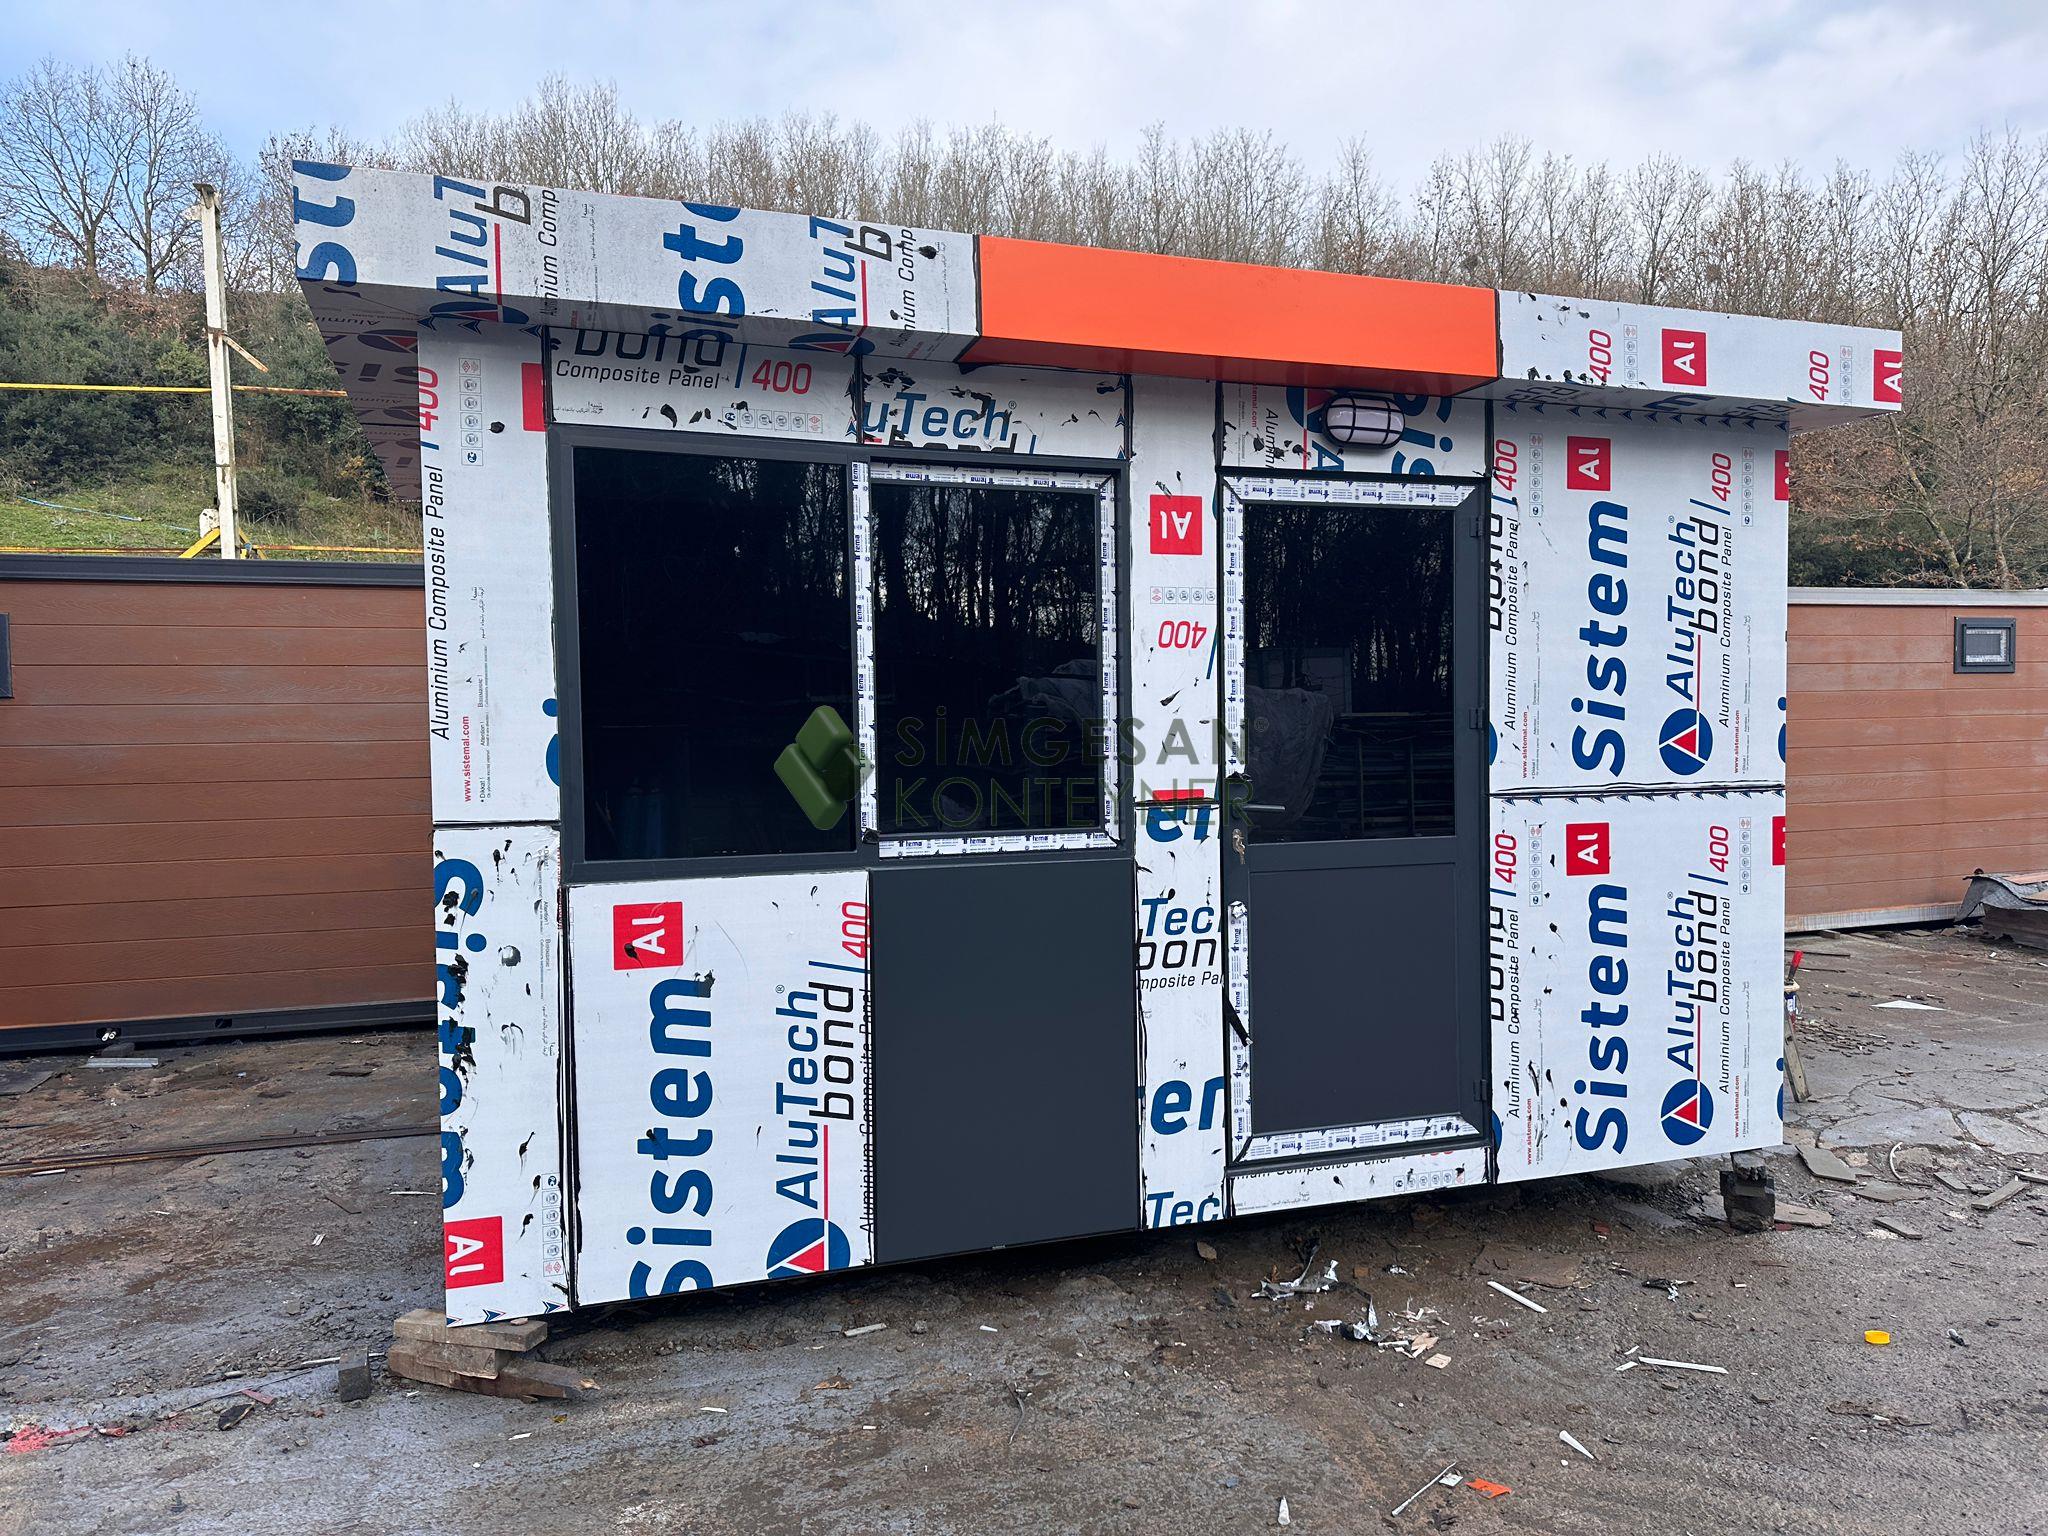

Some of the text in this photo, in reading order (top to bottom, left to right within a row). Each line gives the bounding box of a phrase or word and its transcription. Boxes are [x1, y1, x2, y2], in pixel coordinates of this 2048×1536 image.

[556, 359, 720, 390] Composite Panel
[752, 359, 812, 395] 400
[1589, 329, 1612, 386] 400
[1809, 350, 1830, 401] 400
[1495, 439, 1518, 491] 400
[1578, 447, 1600, 481] Al
[1688, 452, 1732, 634] bond 400
[424, 464, 450, 741] Aluminium Composite Panel
[1504, 518, 1519, 731] Aluminium Composite Panel
[1718, 527, 1732, 728] Aluminium Composite Panel
[1158, 620, 1207, 649] 400
[1570, 500, 1629, 778] Sistem
[461, 715, 471, 802] www.sistemal.com
[1495, 832, 1518, 883] 400
[1577, 831, 1599, 865] Al
[632, 914, 666, 954] Al
[1142, 897, 1221, 937] Tec
[1688, 825, 1729, 1003] bond 400
[1201, 971, 1224, 985] Pa
[1719, 896, 1731, 1095] Aluminium Composite Panel
[1506, 909, 1521, 1118] Aluminium Composite Panel
[1574, 883, 1629, 1155] Sistem
[807, 981, 854, 1120] bond
[627, 978, 713, 1300] Sistem
[448, 1234, 485, 1277] Al
